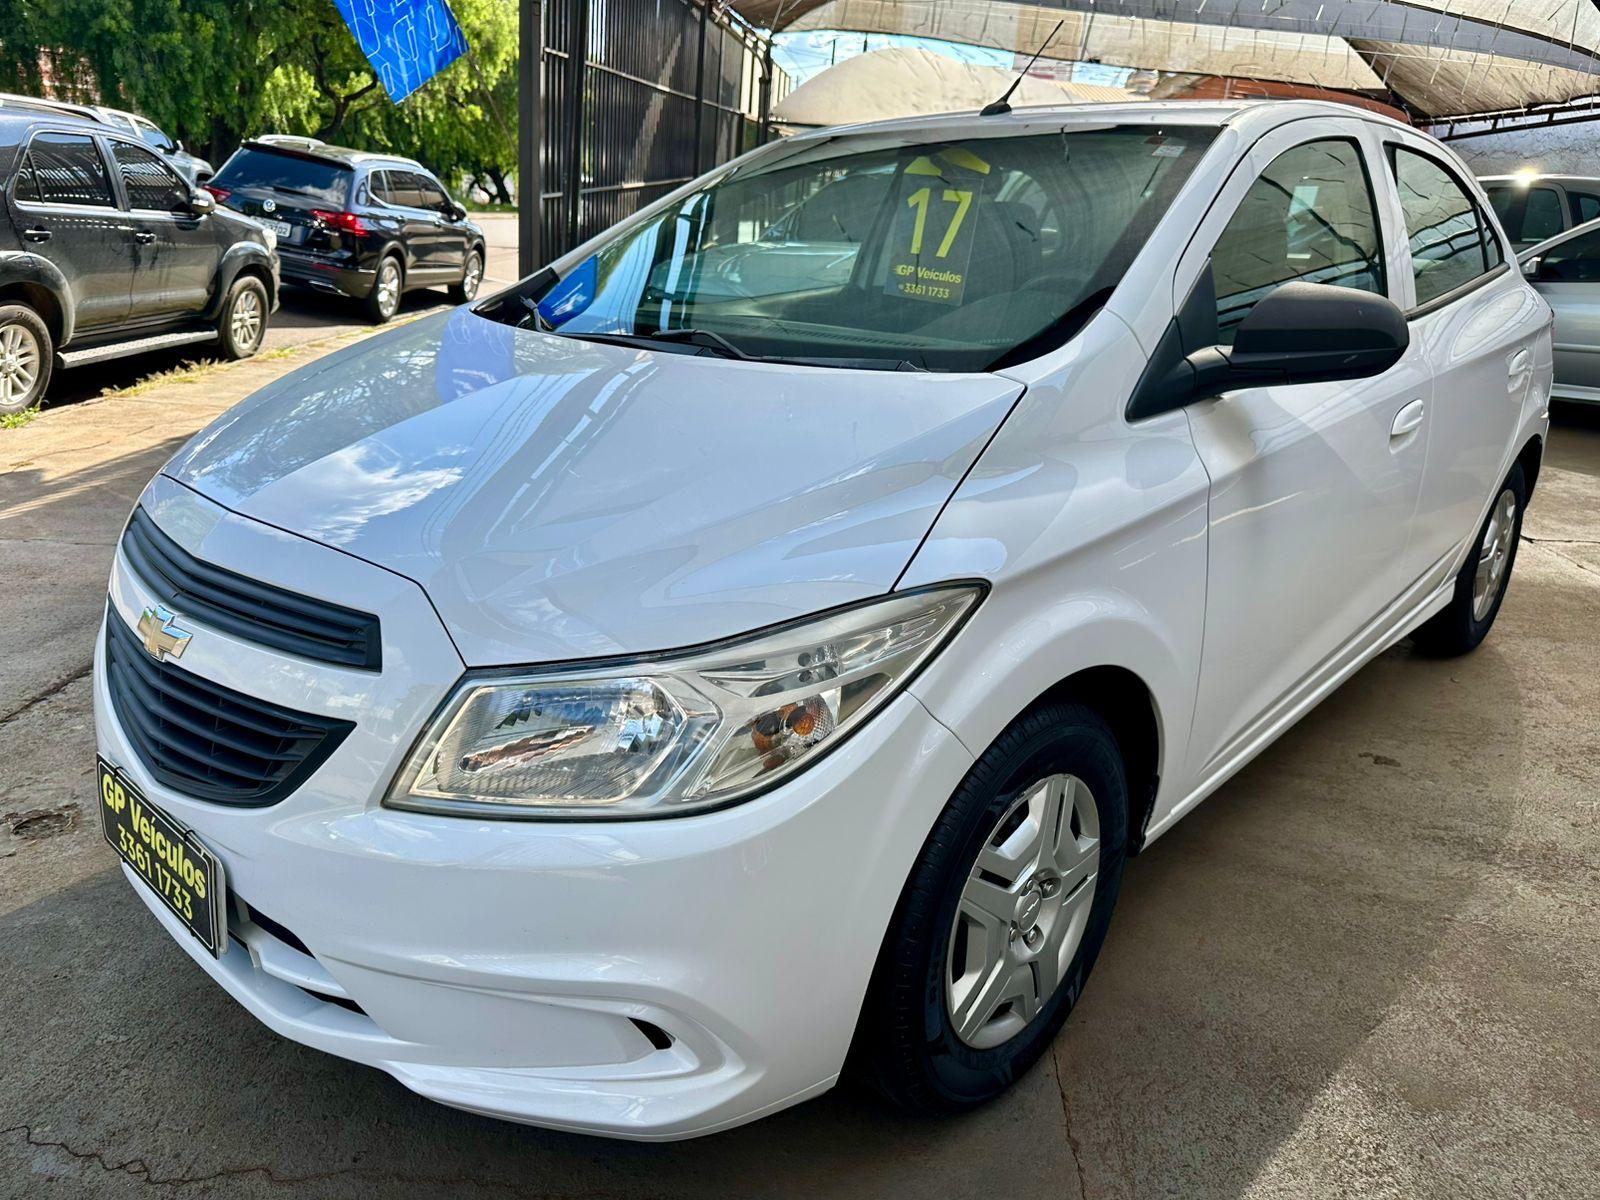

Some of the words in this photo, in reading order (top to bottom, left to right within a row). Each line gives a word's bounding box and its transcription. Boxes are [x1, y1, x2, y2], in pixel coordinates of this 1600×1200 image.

[907, 188, 973, 258] 17
[898, 265, 915, 276] GP
[917, 266, 962, 284] Veículos
[904, 283, 926, 295] 3361
[928, 286, 950, 299] 1733
[102, 774, 125, 814] GP
[129, 798, 206, 898] Veículos
[118, 823, 152, 879] 3361
[155, 862, 193, 920] 1733
